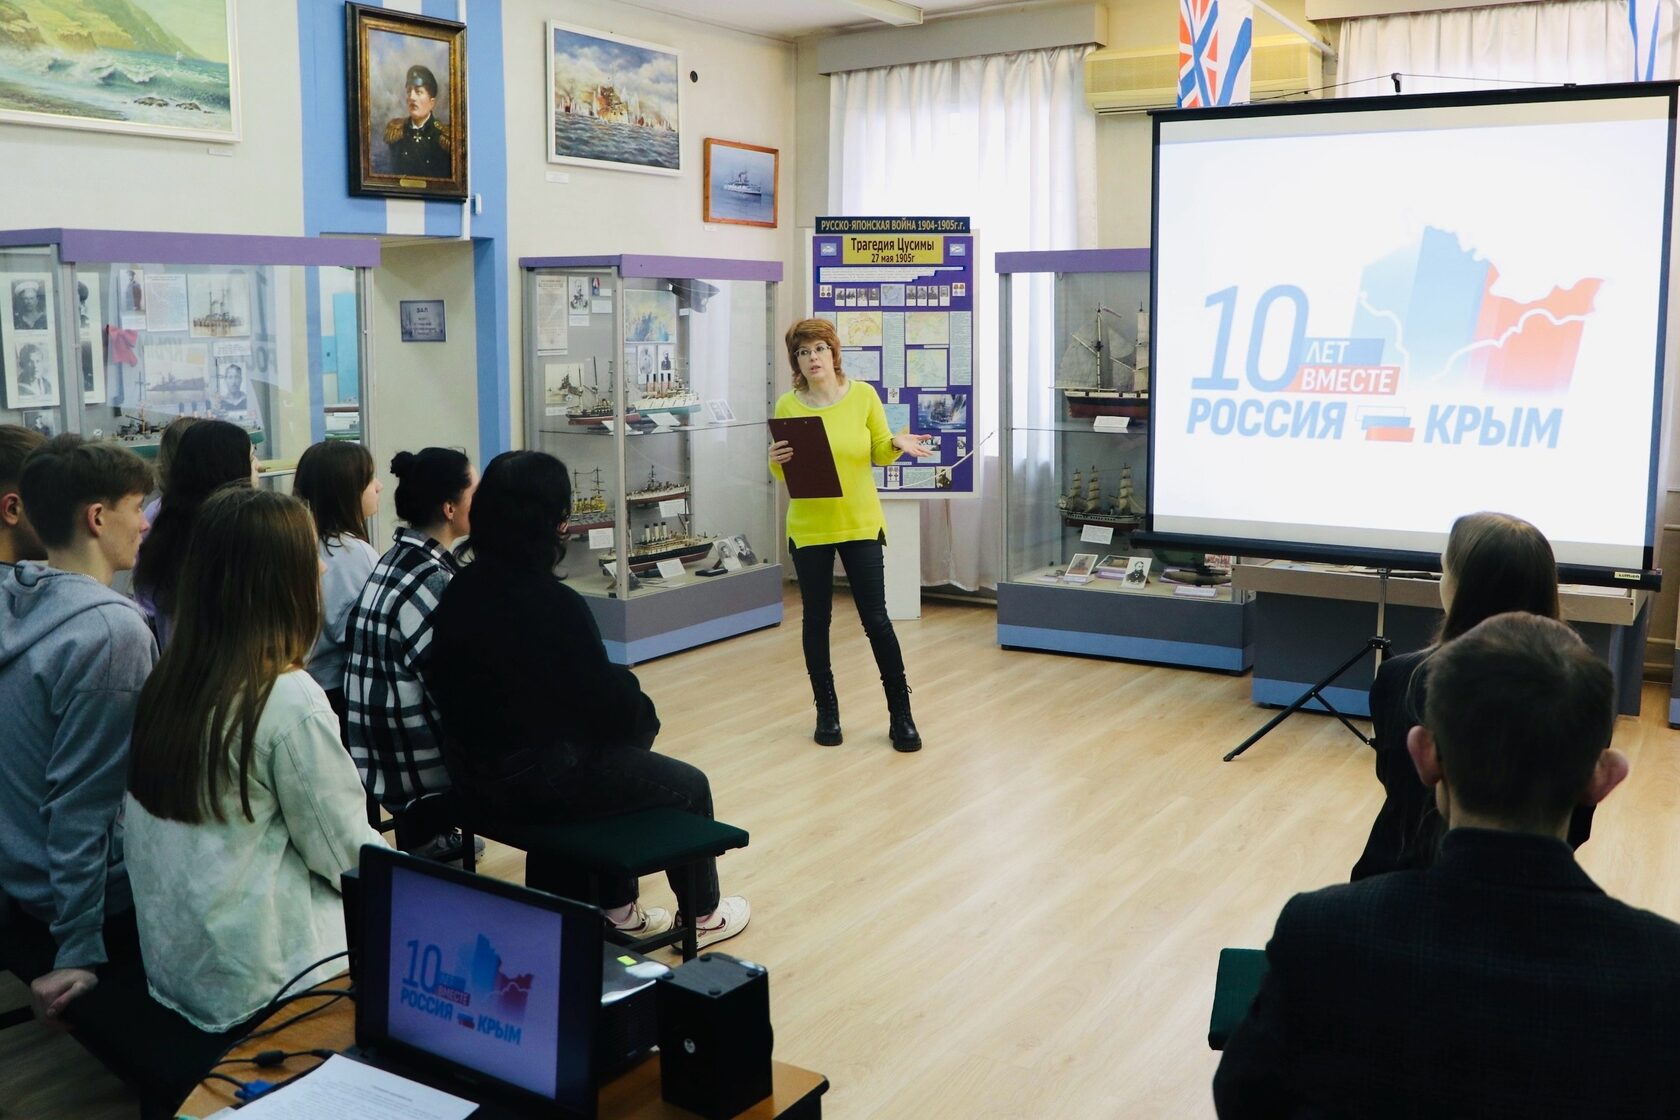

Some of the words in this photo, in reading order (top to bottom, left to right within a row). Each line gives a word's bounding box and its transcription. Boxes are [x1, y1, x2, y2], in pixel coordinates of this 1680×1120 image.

[821, 220, 890, 231] РУССКО-ЯПОНСКАЯ
[892, 217, 917, 230] ВОЙНА
[918, 219, 966, 230] 1904-1905г.г.
[850, 237, 895, 253] Трагедия
[897, 237, 935, 253] Цусимы
[871, 253, 880, 263] 27
[881, 255, 894, 263] мая
[895, 253, 915, 263] 1905г
[1191, 284, 1310, 393] 10
[1306, 341, 1350, 364] ЛЕТ
[1301, 367, 1394, 393] ВМЕСТЕ
[1186, 397, 1348, 440] РОССИЯ
[1424, 404, 1563, 449] КРЫМ
[403, 941, 442, 993] 10
[401, 986, 453, 1022] РОССИЯ
[477, 1014, 521, 1044] КРЫМ
